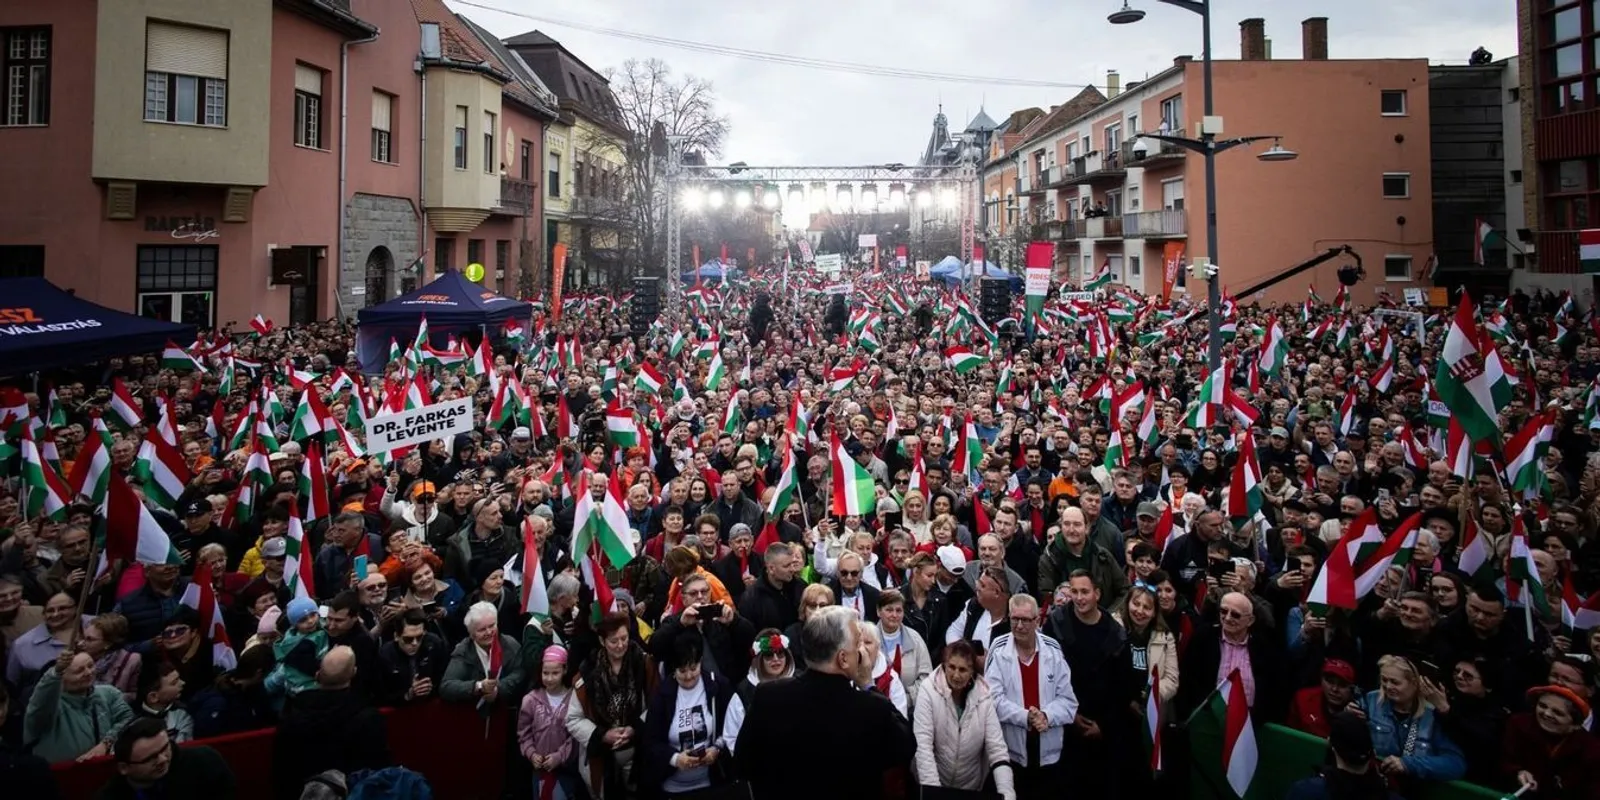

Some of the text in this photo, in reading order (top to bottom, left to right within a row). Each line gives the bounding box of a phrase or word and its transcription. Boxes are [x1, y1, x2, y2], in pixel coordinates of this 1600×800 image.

[373, 405, 466, 434] DR. FARKAS
[387, 418, 456, 443] LEVENTE
